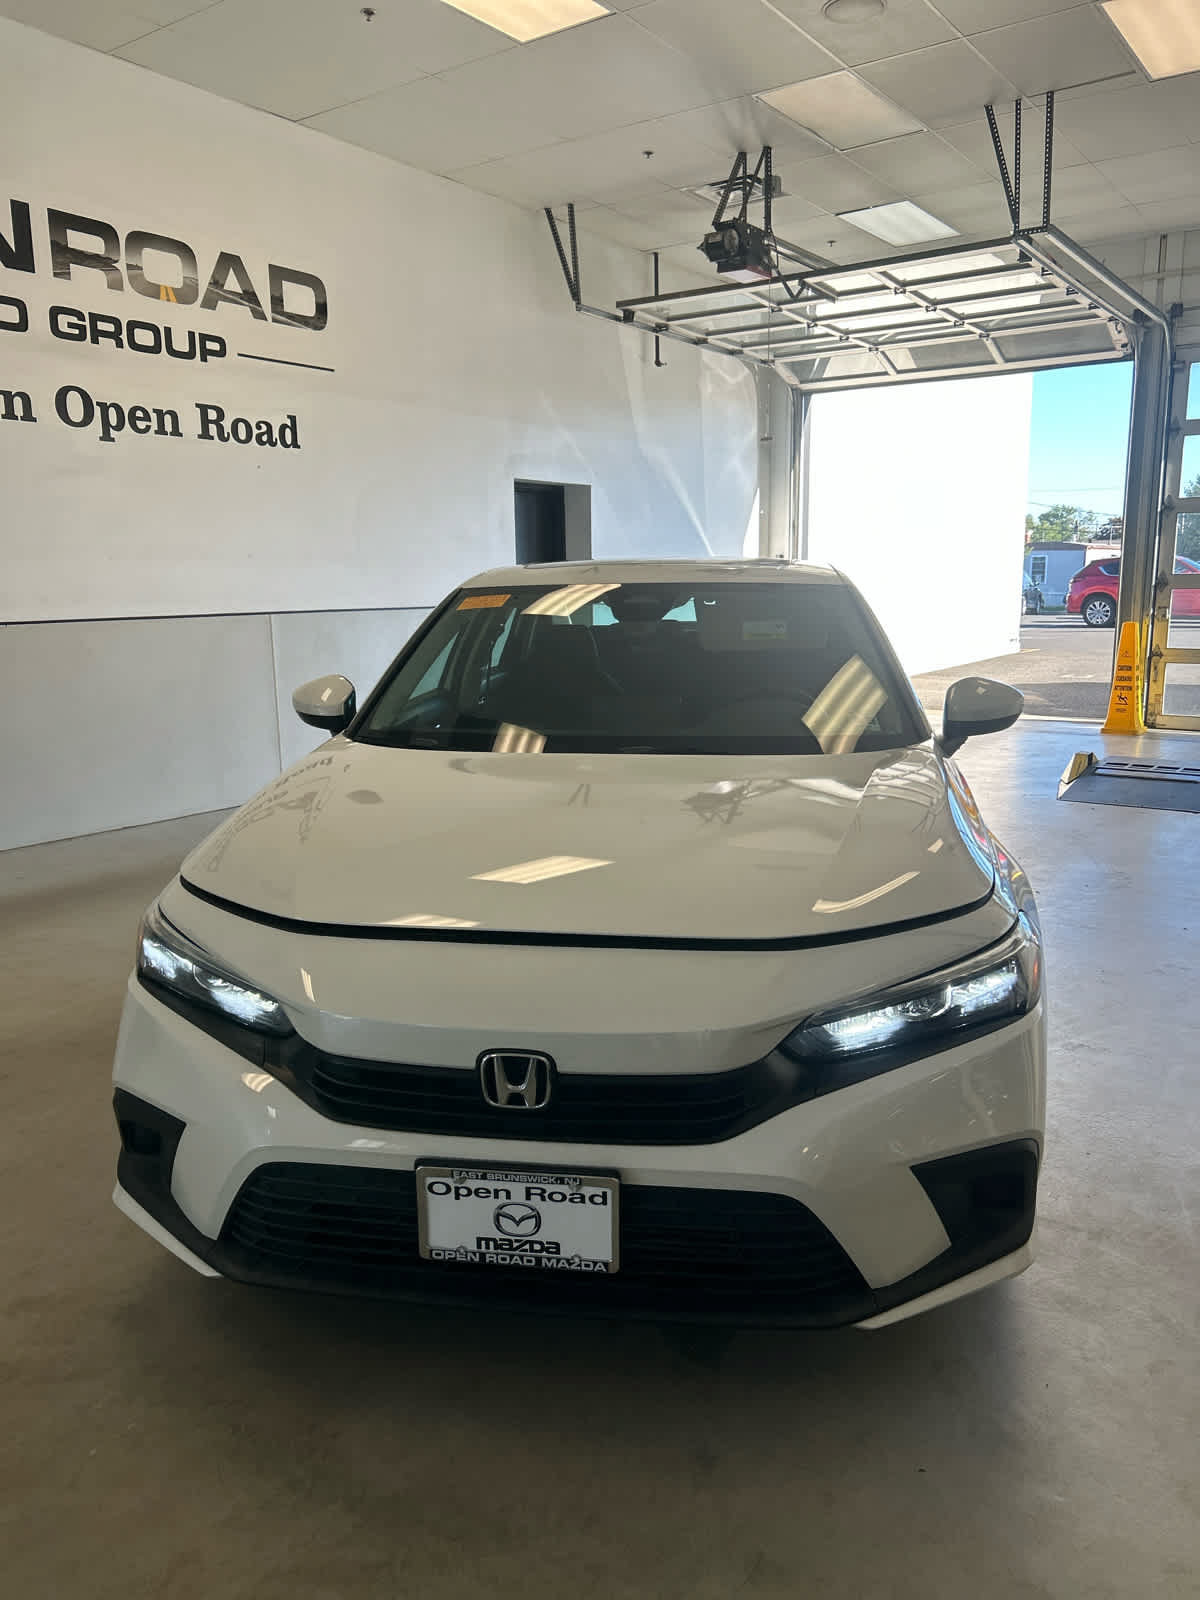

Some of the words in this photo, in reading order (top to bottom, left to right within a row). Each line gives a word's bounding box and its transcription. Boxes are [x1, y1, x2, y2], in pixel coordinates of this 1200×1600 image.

[49, 305, 227, 362] GROUP
[54, 385, 183, 442] Open
[195, 402, 301, 449] Road
[452, 1170, 482, 1180] EAST
[487, 1173, 560, 1185] BRUNSWICK,
[565, 1177, 581, 1185] NJ
[427, 1181, 511, 1200] Open
[525, 1186, 608, 1206] Road
[476, 1236, 561, 1255] mazda
[431, 1250, 480, 1262] OPEN
[485, 1253, 536, 1266] ROAD
[541, 1257, 607, 1272] MAZDA
